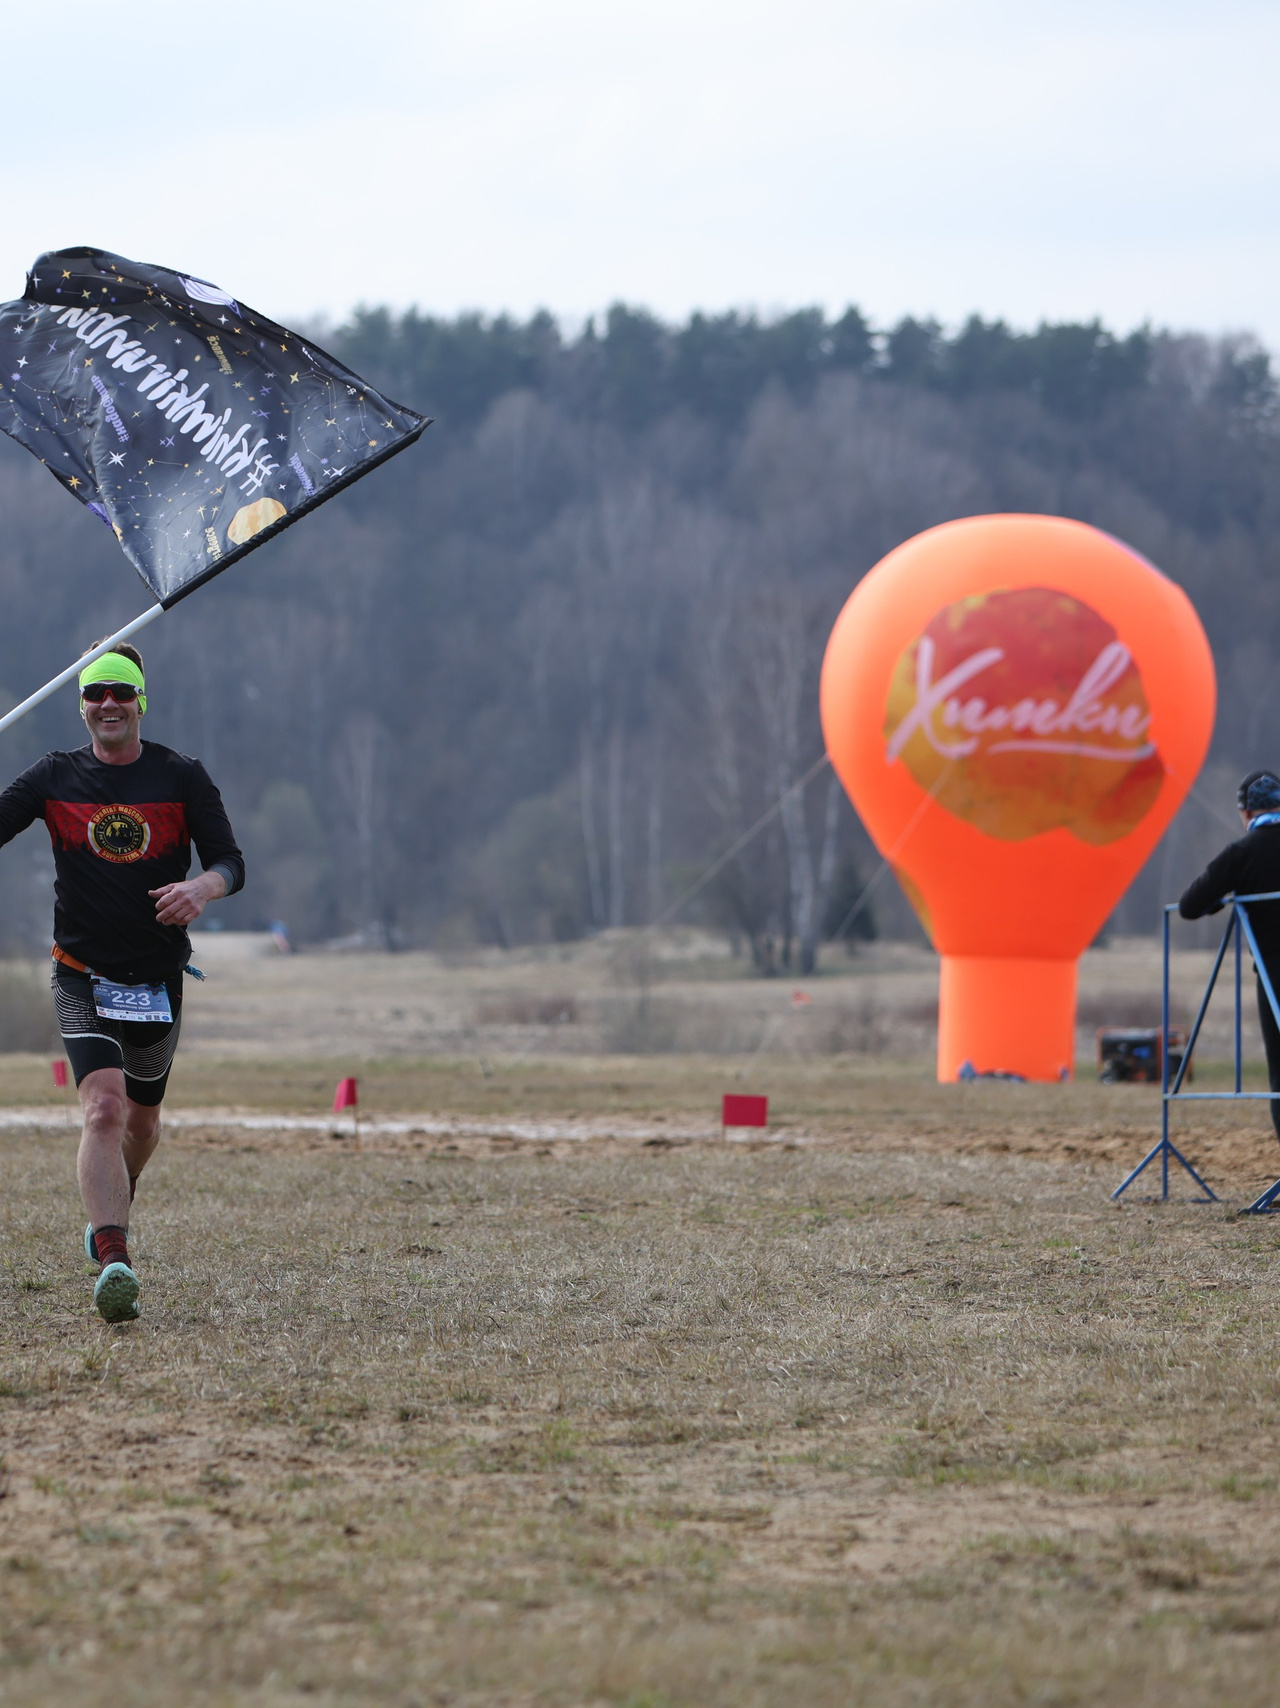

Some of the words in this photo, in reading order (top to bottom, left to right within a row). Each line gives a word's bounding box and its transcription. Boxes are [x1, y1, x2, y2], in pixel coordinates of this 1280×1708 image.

[887, 636, 1154, 763] Химки
[93, 806, 117, 823] SPARTAK
[118, 806, 144, 823] MOSCOW
[102, 850, 140, 862] SUPPORTERS
[110, 990, 151, 1006] 223
